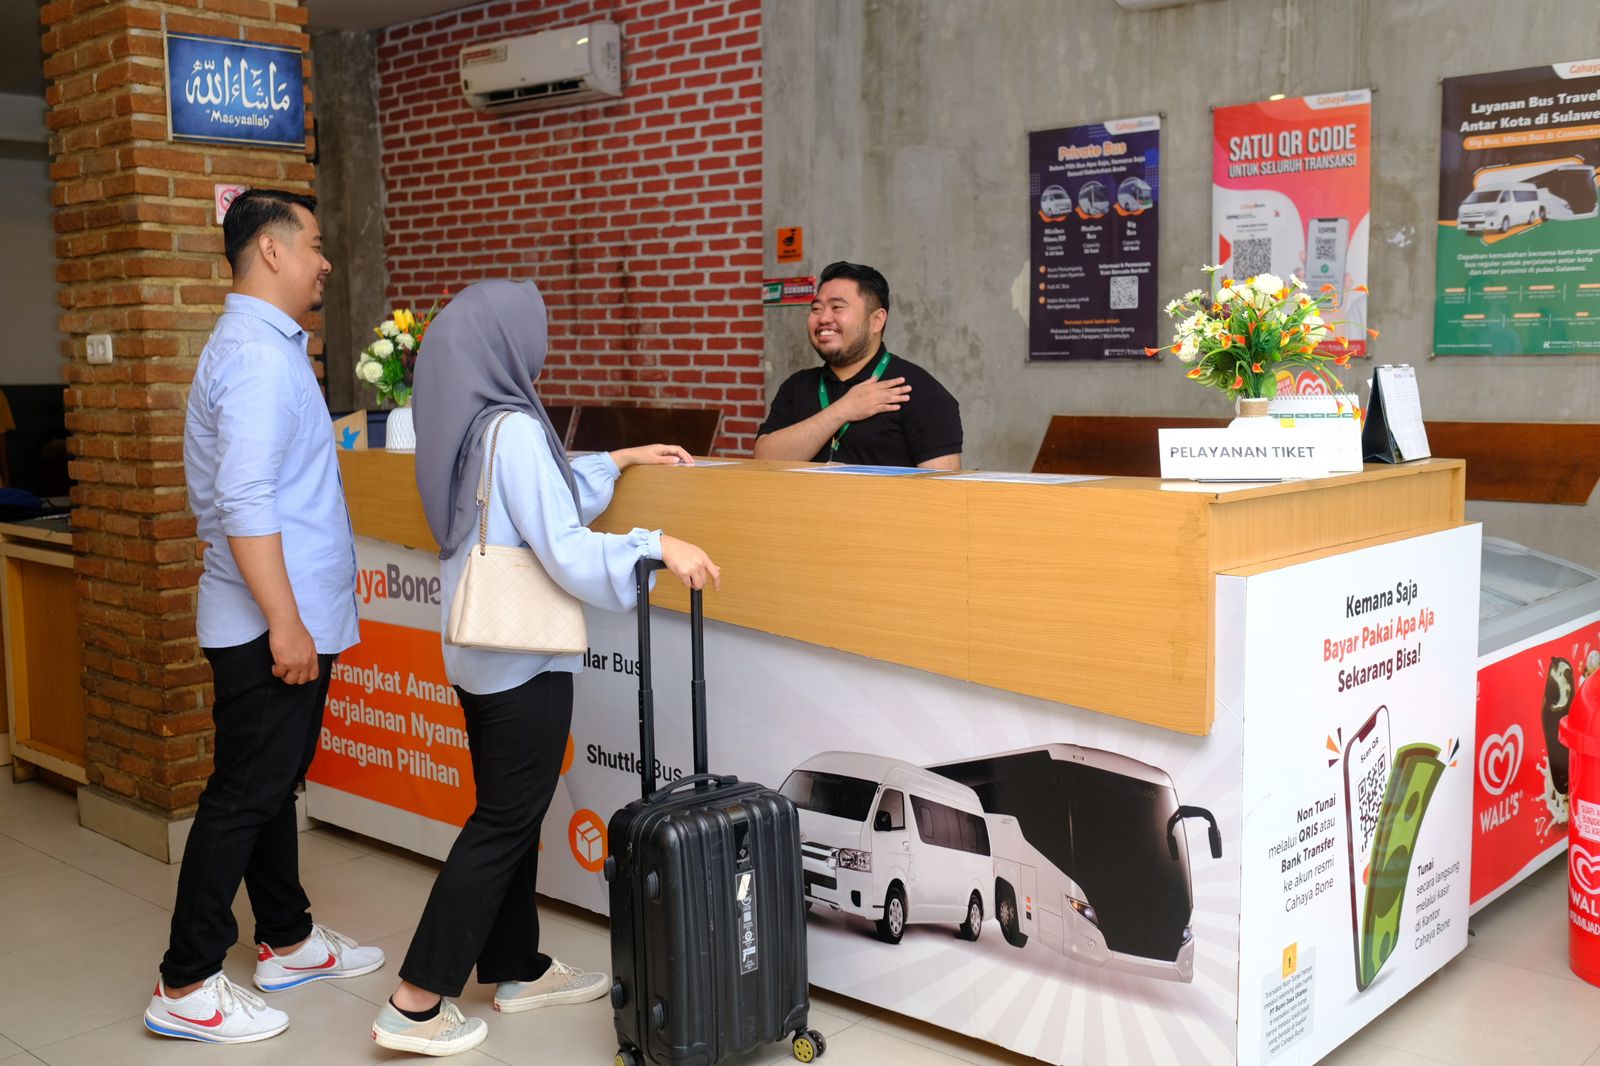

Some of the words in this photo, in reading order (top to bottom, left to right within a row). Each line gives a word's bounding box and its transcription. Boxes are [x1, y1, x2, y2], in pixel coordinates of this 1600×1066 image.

[1471, 100, 1525, 116] Layanan
[1528, 96, 1554, 108] Bus
[1557, 89, 1600, 104] Travel
[1460, 120, 1497, 132] Antar
[1500, 116, 1532, 128] Kota
[1534, 112, 1548, 124] di
[1058, 144, 1102, 162] Private
[1102, 140, 1127, 156] Bus
[1230, 132, 1273, 161] SATU
[1278, 130, 1303, 158] QR
[1308, 124, 1357, 154] CODE
[1228, 163, 1260, 178] UNTUK
[1261, 158, 1302, 176] SELURUH
[1304, 154, 1357, 171] TRANSAKSI
[1170, 446, 1268, 458] PELAYANAN
[1272, 446, 1316, 458] TIKET
[1346, 590, 1393, 618] Kemana
[1396, 579, 1418, 606] Saja
[1323, 634, 1359, 663] Bayar
[1362, 618, 1393, 648] Pakai
[1396, 616, 1416, 640] Apa
[1418, 607, 1434, 633] Aja
[613, 652, 641, 676] Bus
[1338, 656, 1393, 693] Sekarang
[1396, 642, 1422, 672] Bisa!
[330, 662, 402, 694] erangkat
[406, 672, 458, 707] Aman
[410, 712, 470, 750] Nyama
[320, 727, 393, 768] Beragam
[397, 748, 460, 788] Pilihan
[586, 744, 643, 774] Shuttle
[654, 760, 682, 782] Bus
[1360, 746, 1372, 764] Scan
[1372, 736, 1380, 748] QR
[1296, 804, 1314, 824] Non
[1314, 792, 1336, 813] Tunai
[1480, 792, 1519, 834] WALL'S
[1268, 832, 1297, 859] melalui
[1298, 821, 1318, 844] QRIS
[1320, 816, 1336, 832] atau
[1281, 852, 1302, 873] Bank
[1303, 836, 1335, 862] Transfer
[1284, 879, 1293, 894] ke
[1294, 867, 1313, 886] akun
[1314, 854, 1335, 875] resmi
[1416, 878, 1434, 896] secara
[1435, 860, 1460, 886] langsung
[1417, 858, 1434, 878] Tunai
[1285, 891, 1313, 913] Cahaya
[1315, 877, 1334, 896] Bone
[1416, 892, 1436, 914] melalui
[1437, 884, 1450, 902] kasir
[1414, 928, 1435, 950] Cahaya
[1436, 918, 1451, 937] Bone
[1415, 920, 1421, 932] di
[1422, 908, 1440, 929] Kantor
